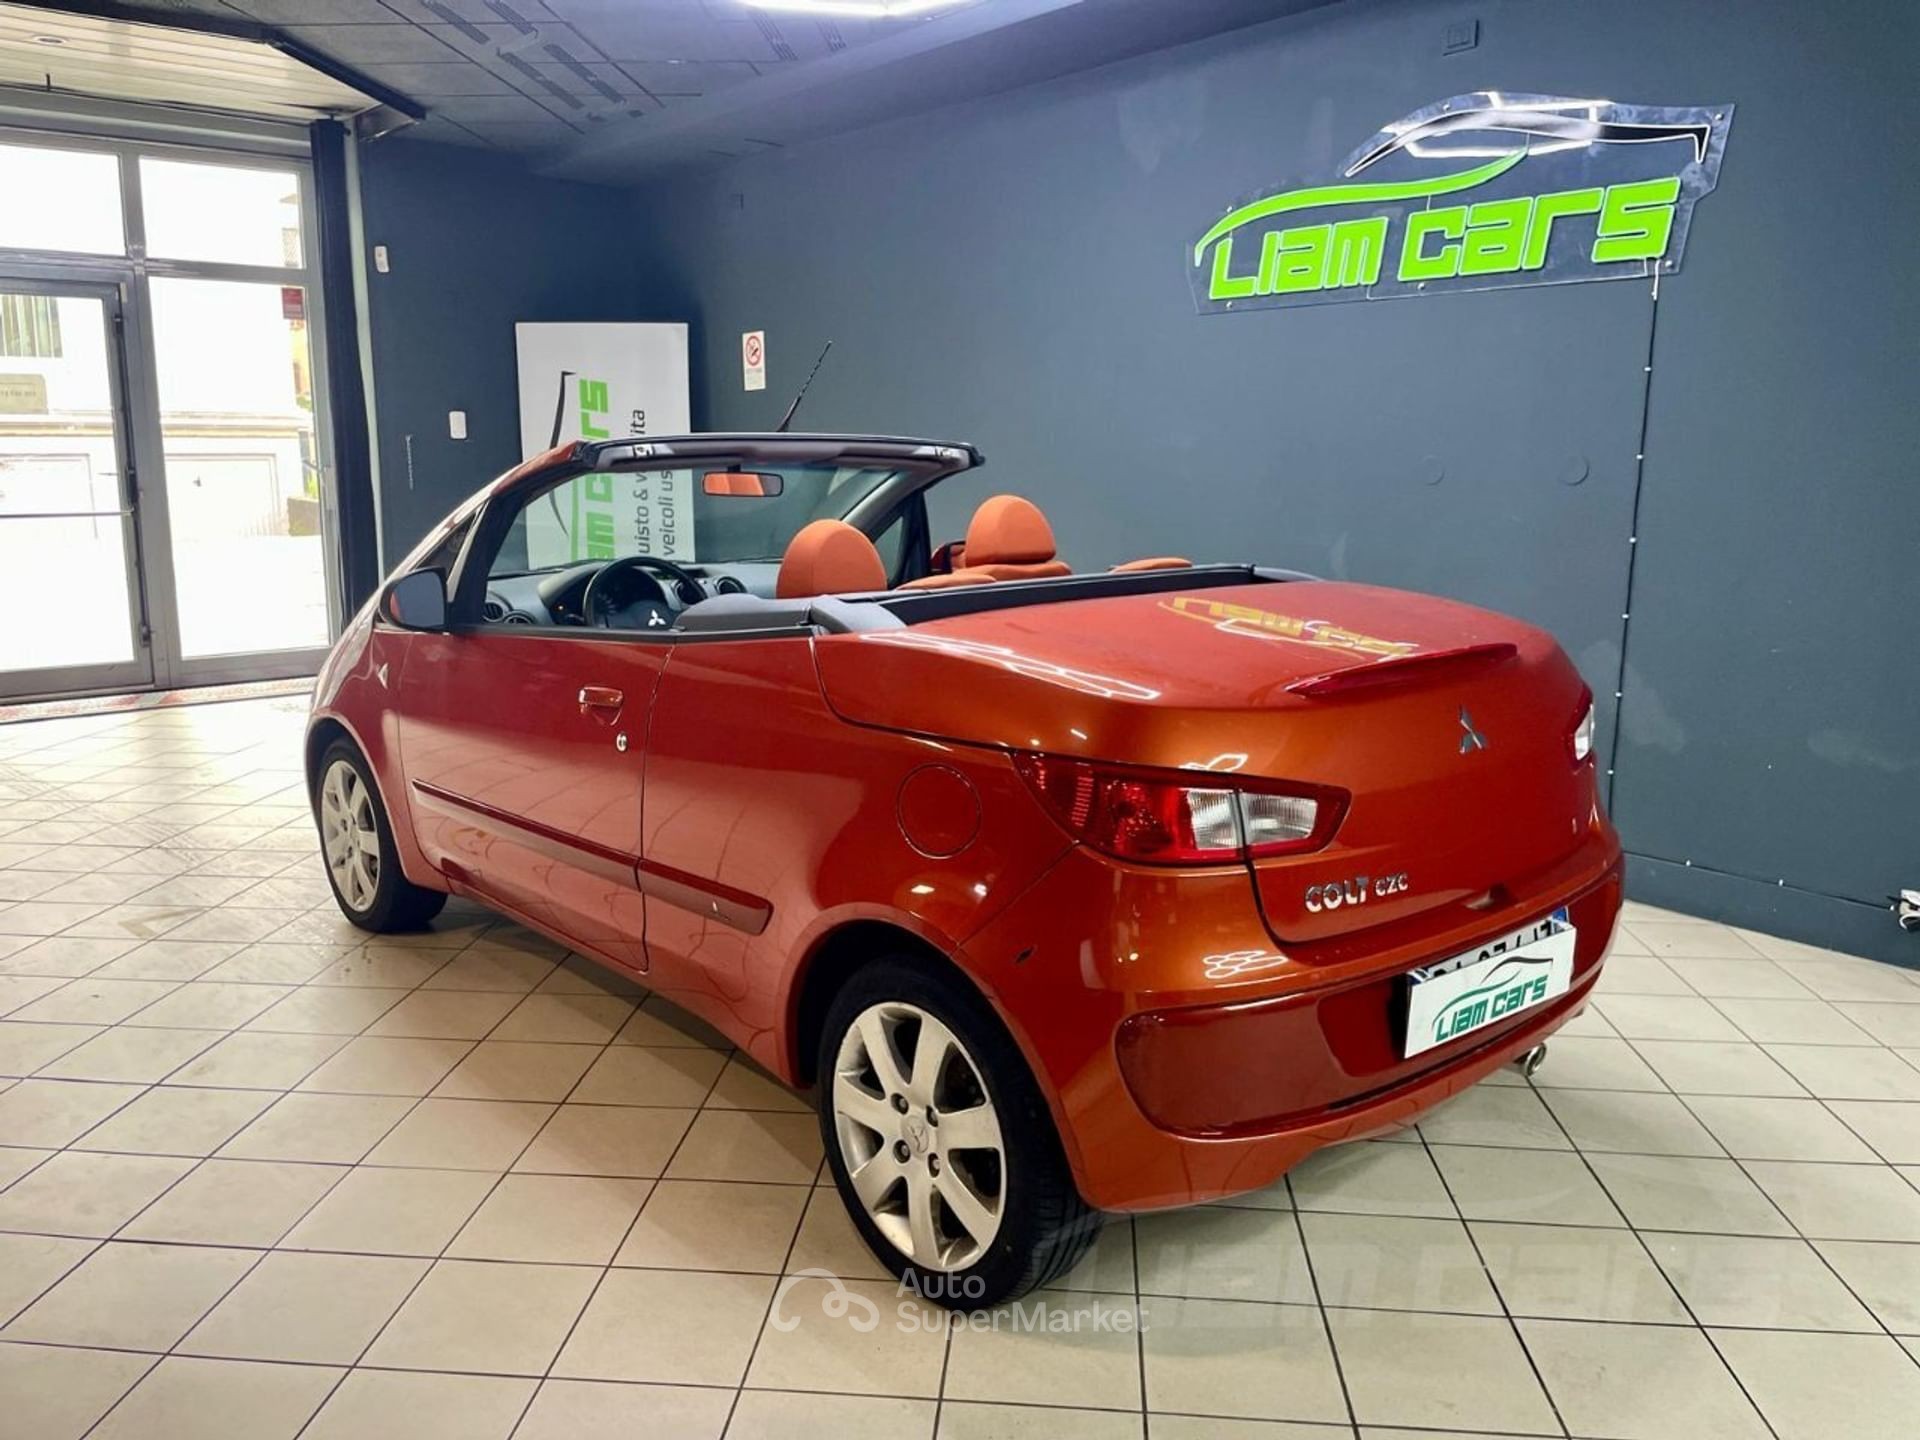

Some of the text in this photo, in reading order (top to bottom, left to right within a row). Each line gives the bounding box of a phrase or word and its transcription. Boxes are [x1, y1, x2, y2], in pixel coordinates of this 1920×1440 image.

[633, 489, 649, 502] &
[658, 496, 675, 557] veicoli
[1305, 876, 1370, 913] COLT
